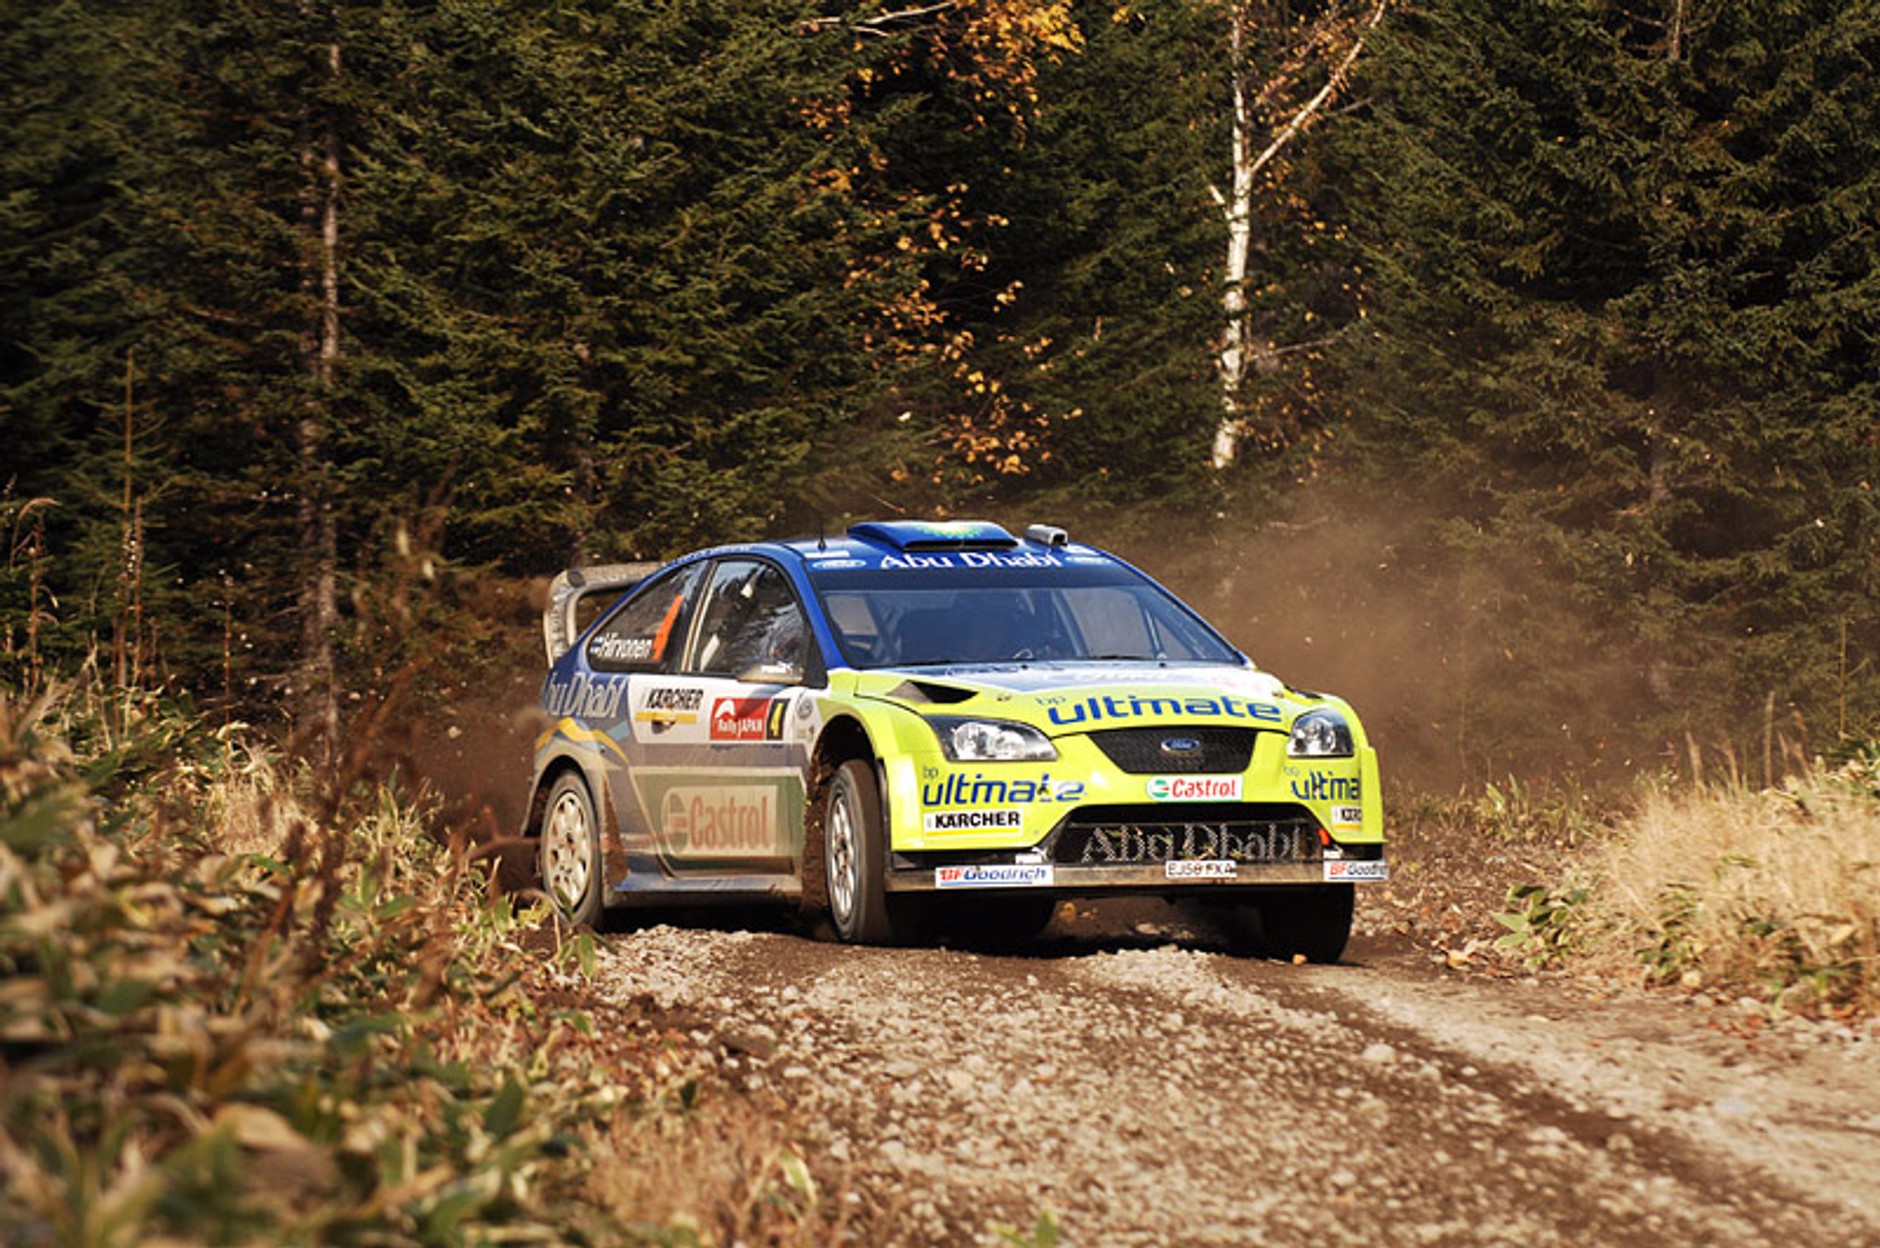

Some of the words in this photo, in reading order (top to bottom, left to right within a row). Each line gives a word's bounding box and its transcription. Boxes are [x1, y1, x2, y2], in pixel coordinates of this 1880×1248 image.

[880, 553, 952, 569] Abu
[962, 551, 1062, 568] Dhabi
[563, 672, 627, 719] Dhabi
[1048, 695, 1282, 725] ultimate
[769, 702, 785, 737] 4
[922, 765, 939, 781] bp
[1172, 778, 1236, 798] Castrol
[689, 794, 769, 851] Castrol
